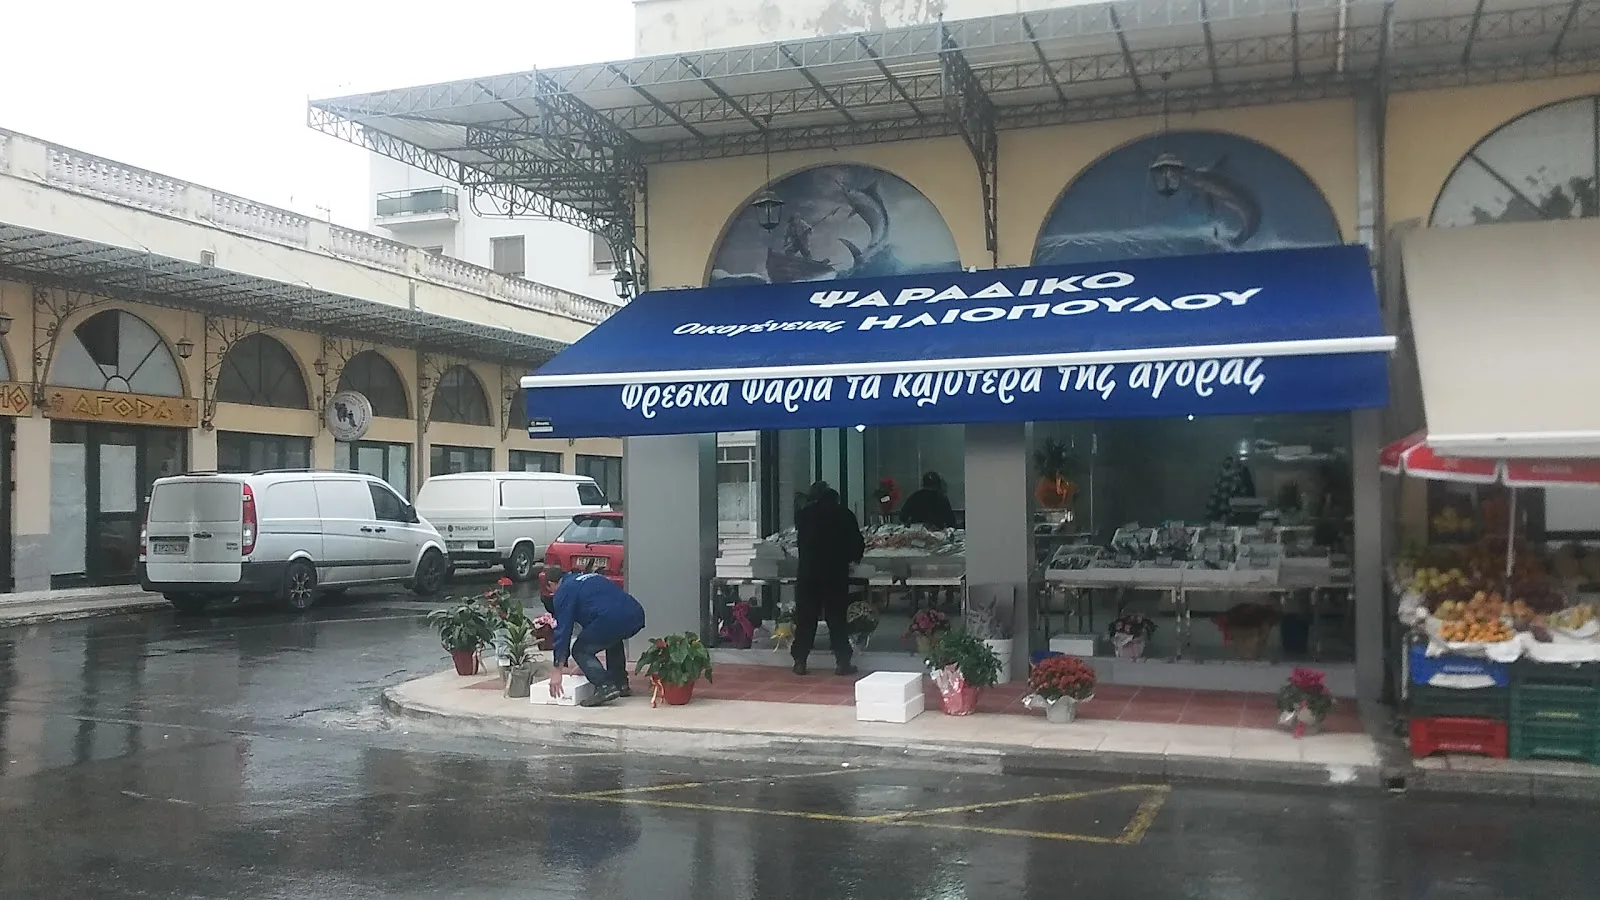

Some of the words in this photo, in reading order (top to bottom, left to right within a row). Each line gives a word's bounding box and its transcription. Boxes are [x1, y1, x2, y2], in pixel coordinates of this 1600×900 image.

[809, 271, 1136, 308] ΨΑΡΑΔΙΚΟ
[672, 319, 847, 338] Οικογένειας
[857, 287, 1264, 331] ΗΛΙΟΠΟΥΛΟΥ
[1128, 357, 1266, 399] αγορας
